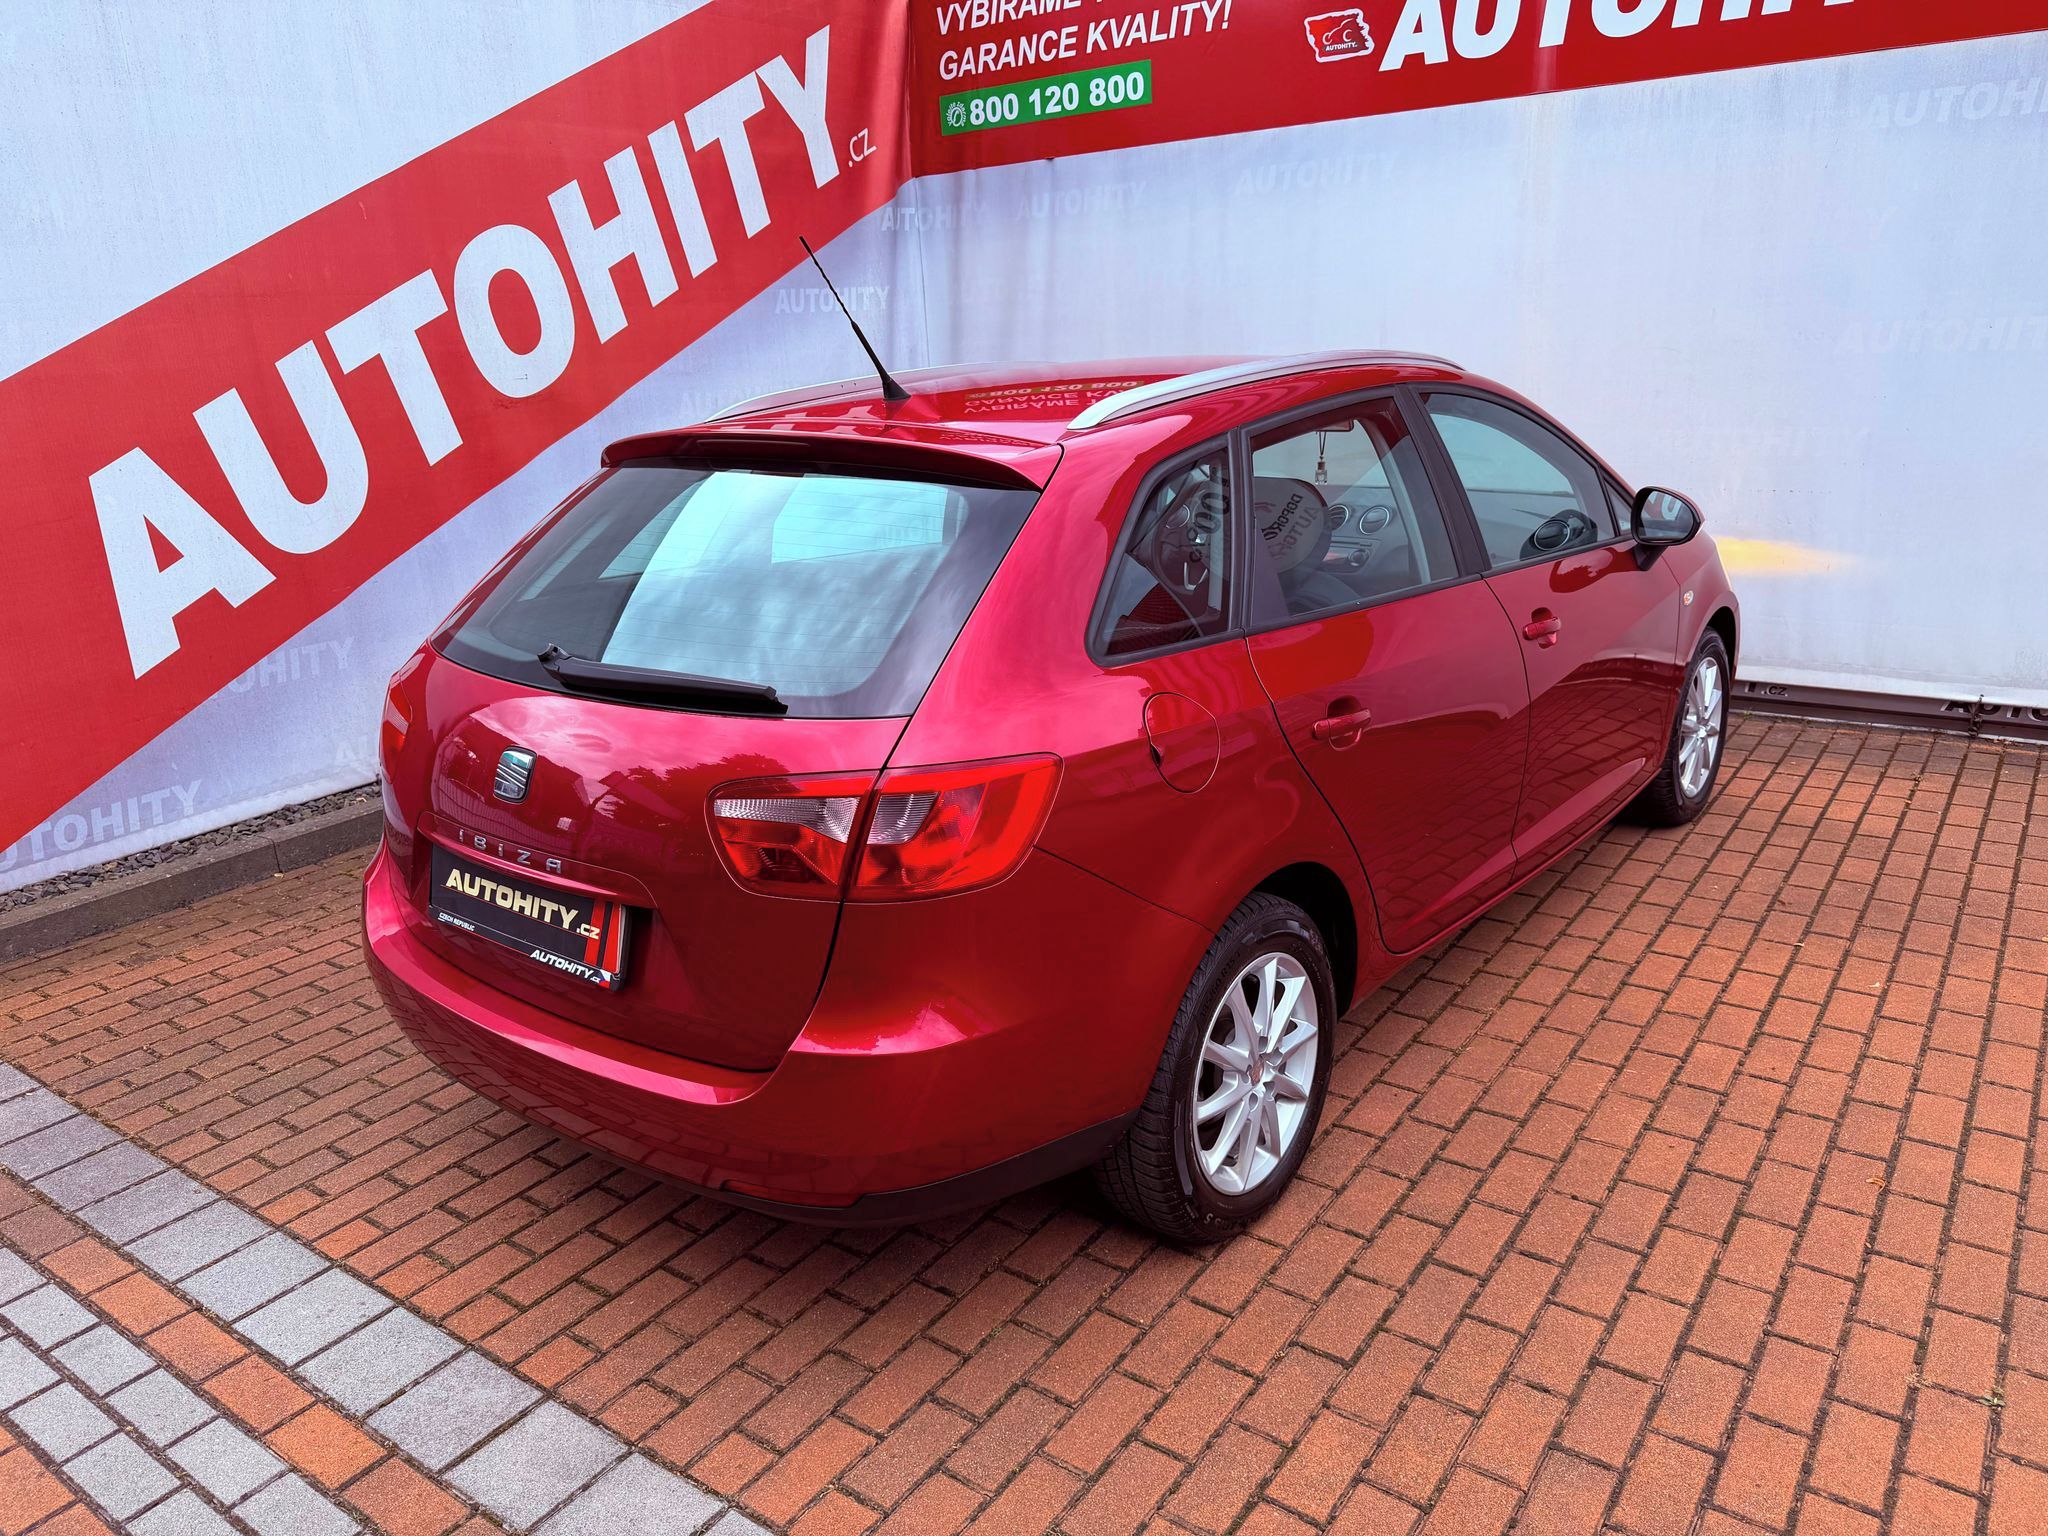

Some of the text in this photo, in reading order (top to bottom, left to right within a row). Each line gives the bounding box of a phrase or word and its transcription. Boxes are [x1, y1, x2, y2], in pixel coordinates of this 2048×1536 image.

[939, 0, 1232, 81] GARANCE KVALITY!
[970, 71, 1145, 126] 800 120 800
[775, 285, 889, 315] AUTOHITY
[459, 829, 562, 874] IBIZA
